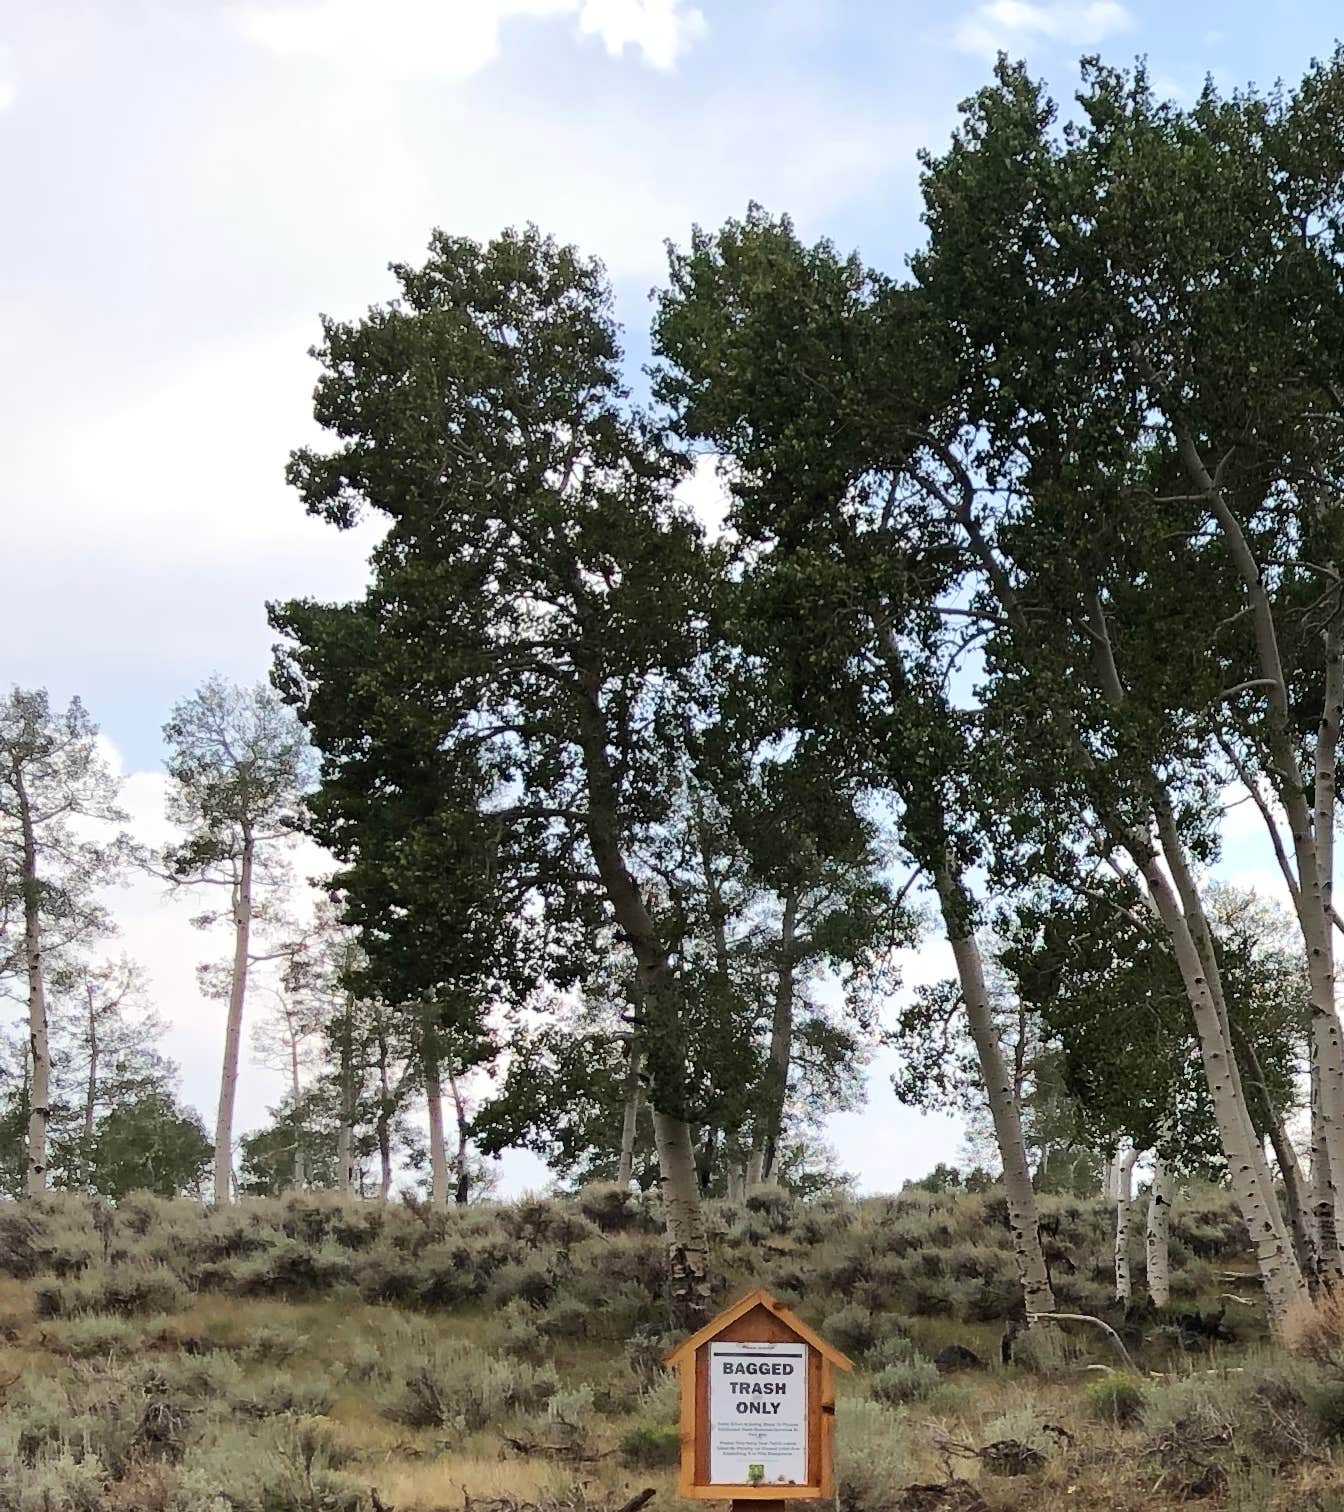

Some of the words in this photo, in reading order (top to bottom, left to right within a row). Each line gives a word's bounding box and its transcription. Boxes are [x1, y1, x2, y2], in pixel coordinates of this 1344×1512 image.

[723, 1362, 794, 1376] BAGGED
[729, 1382, 787, 1395] TRASH
[735, 1401, 781, 1415] ONLY
